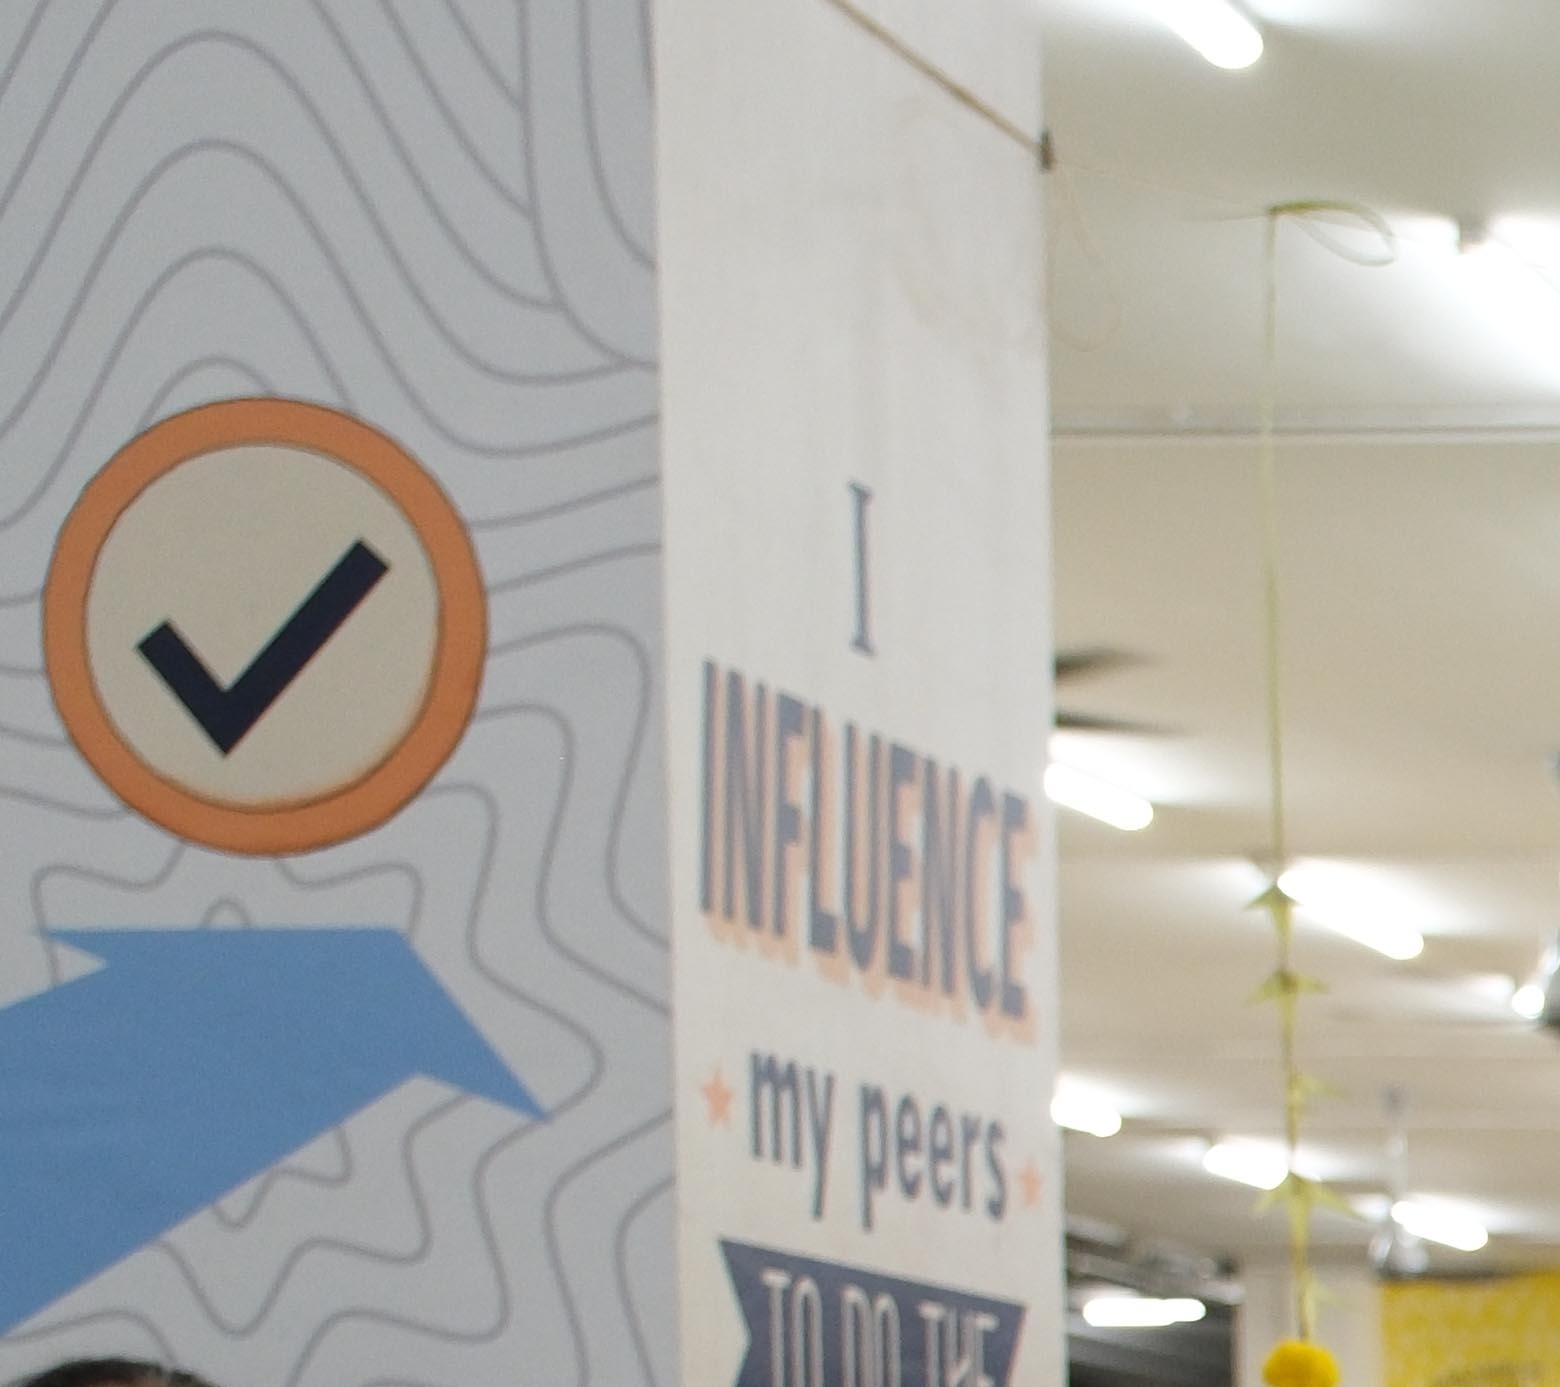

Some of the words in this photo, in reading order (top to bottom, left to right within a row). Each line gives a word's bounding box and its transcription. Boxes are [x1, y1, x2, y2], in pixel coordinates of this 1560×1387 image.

[848, 480, 874, 656] I
[700, 657, 1034, 1042] INFLUENCE
[749, 1052, 835, 1222] my
[859, 1083, 1008, 1231] peers
